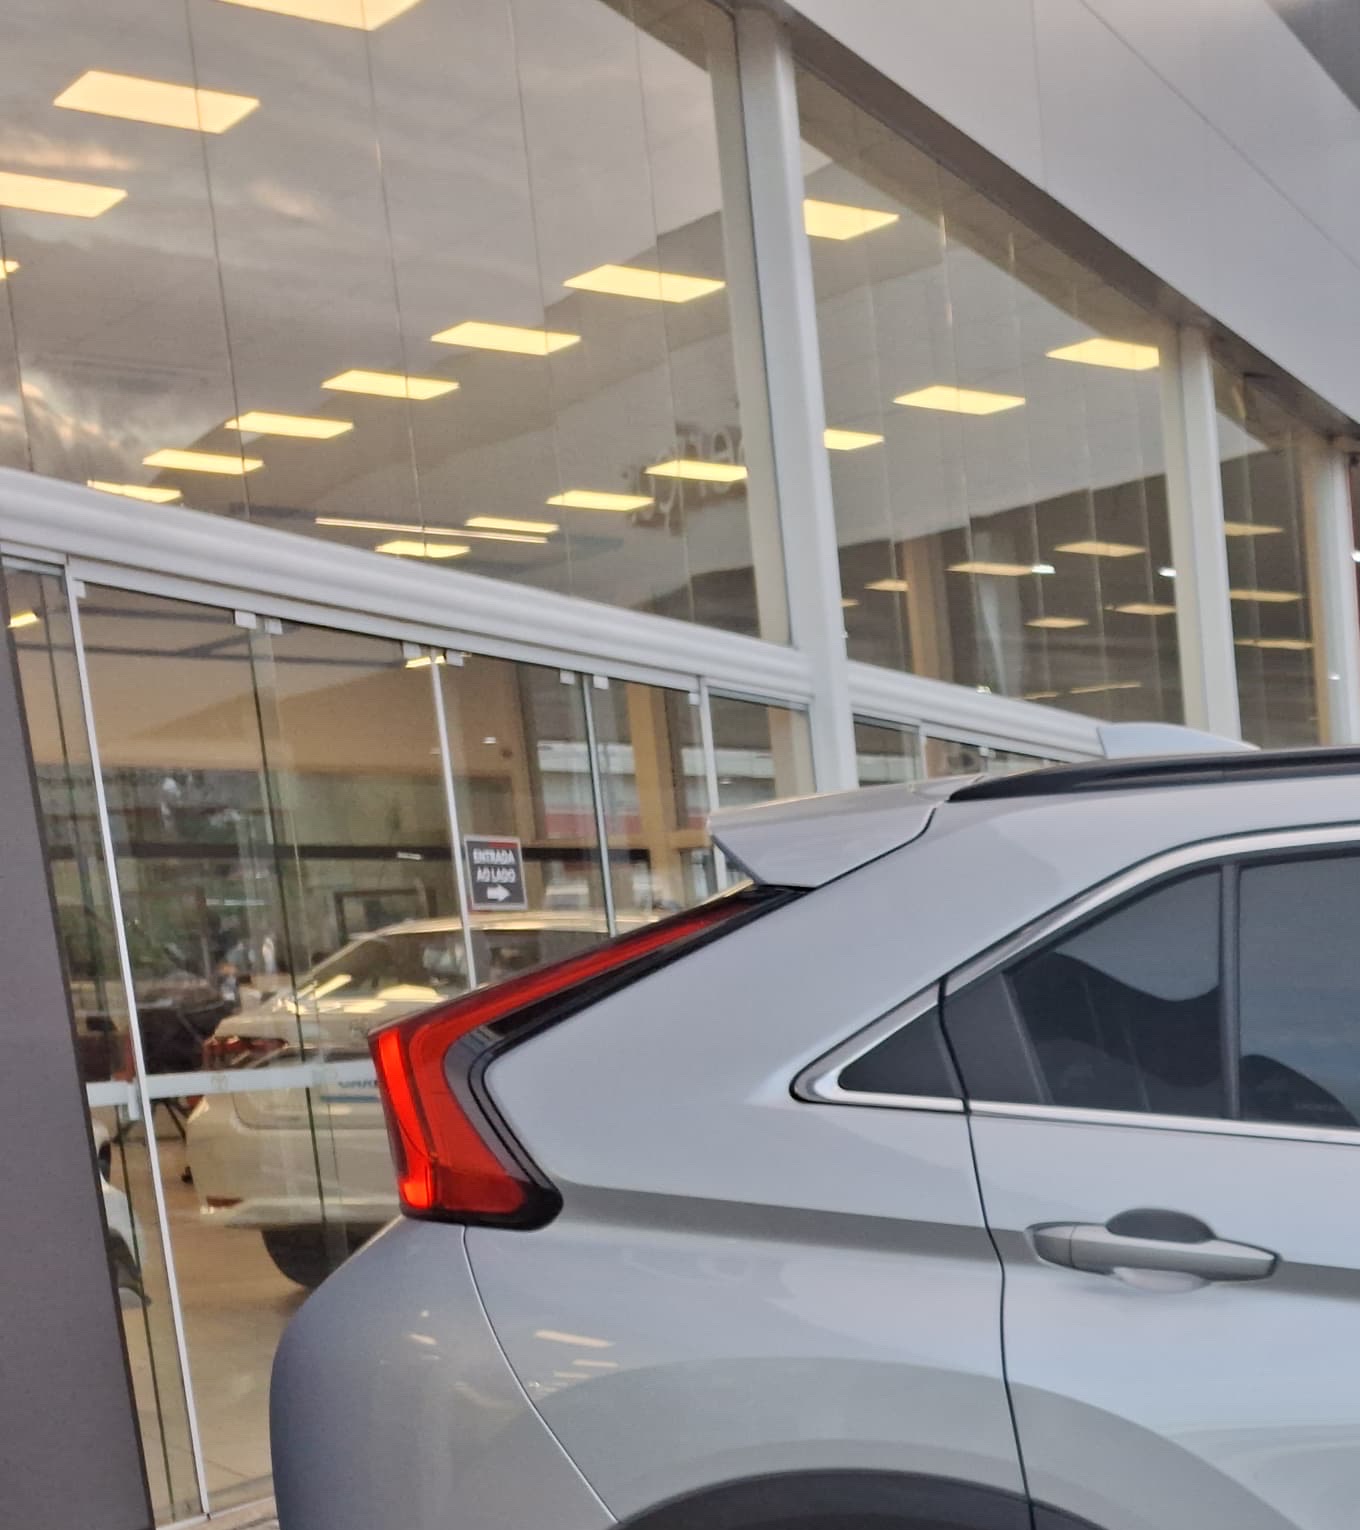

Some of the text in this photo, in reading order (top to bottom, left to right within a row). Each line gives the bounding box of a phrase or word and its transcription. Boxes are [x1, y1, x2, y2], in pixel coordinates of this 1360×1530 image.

[472, 848, 516, 865] ENTRADA
[476, 866, 516, 884] AO LADO
